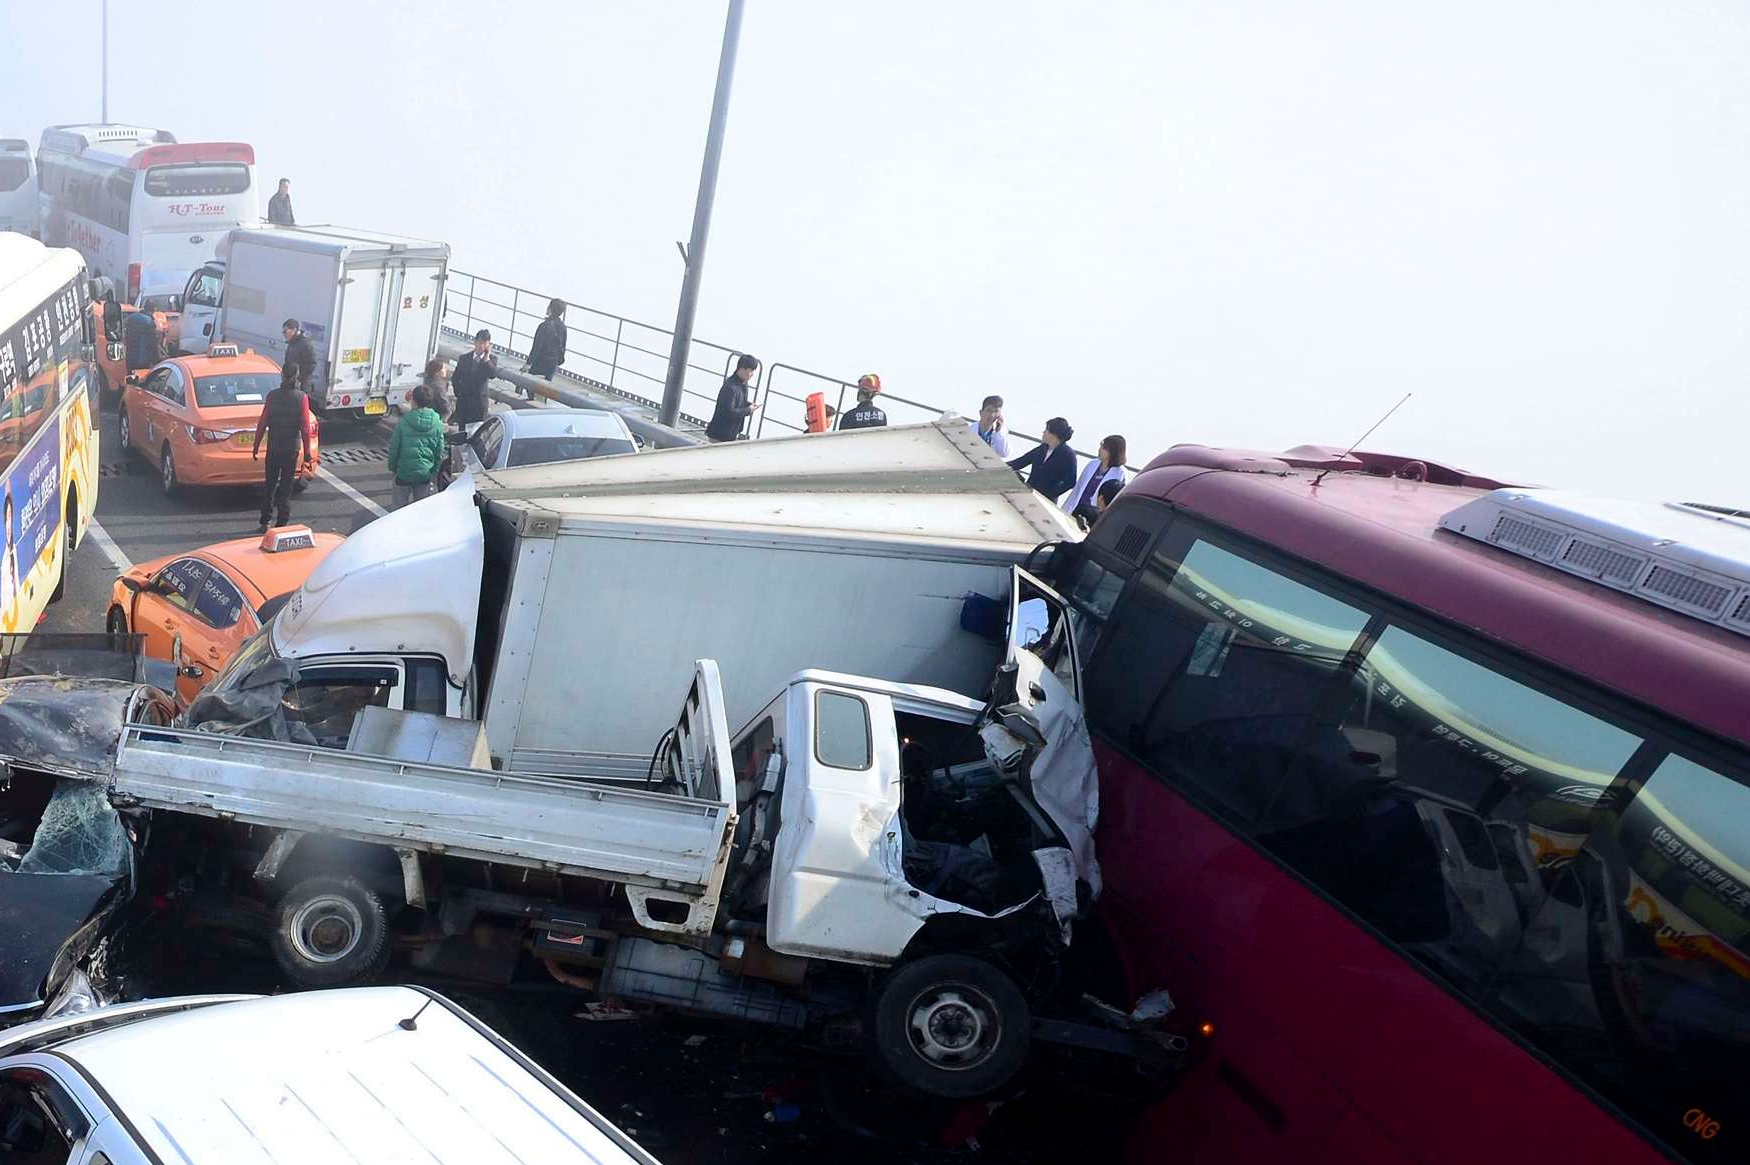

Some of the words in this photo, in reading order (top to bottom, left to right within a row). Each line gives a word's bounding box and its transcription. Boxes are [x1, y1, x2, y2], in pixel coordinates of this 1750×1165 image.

[215, 347, 234, 356] TAXI
[286, 538, 303, 547] TAXI
[1683, 1108, 1721, 1139] CNG
